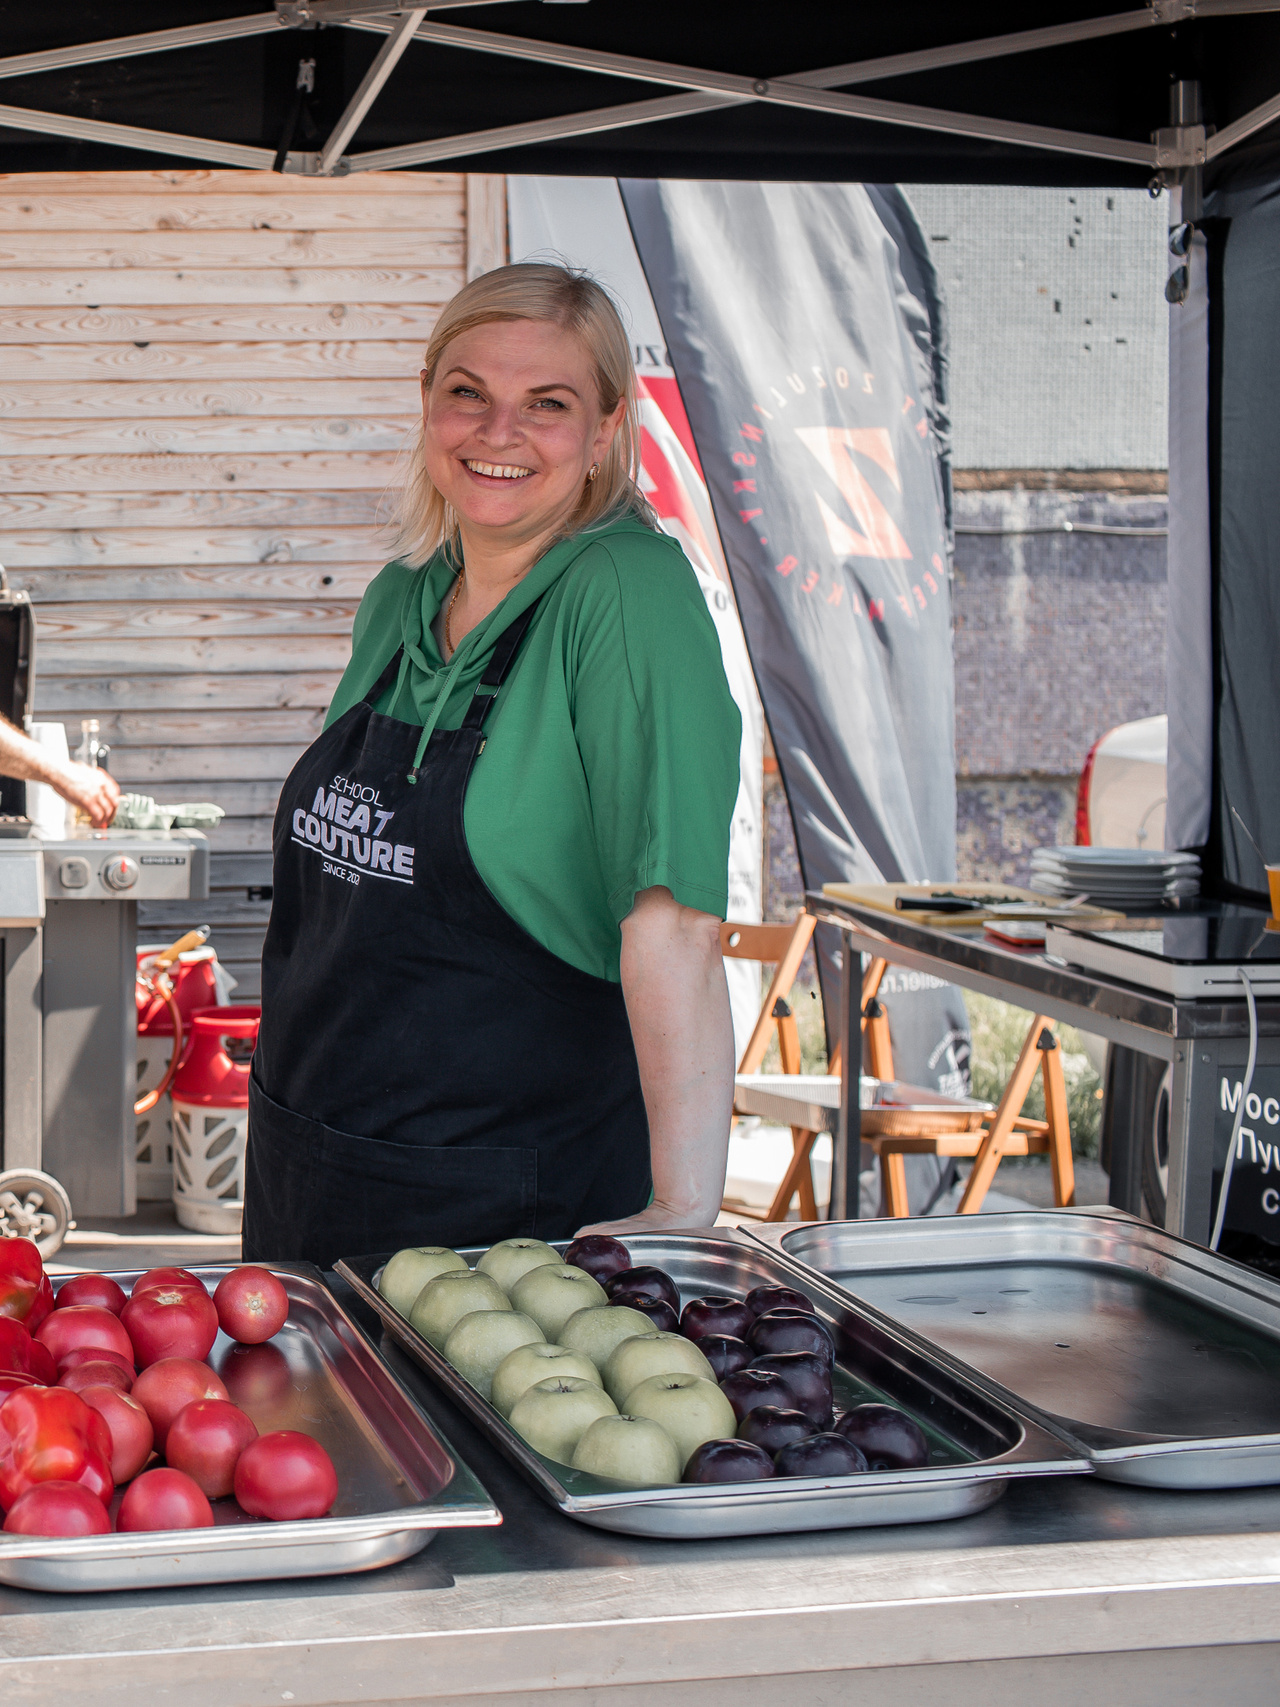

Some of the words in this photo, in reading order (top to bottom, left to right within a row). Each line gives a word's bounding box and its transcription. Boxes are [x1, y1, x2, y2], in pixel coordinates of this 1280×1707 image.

[311, 786, 395, 836] MEAT
[329, 775, 384, 807] SCHOOL
[292, 808, 415, 877] COUTURE
[322, 861, 347, 880] SINCE
